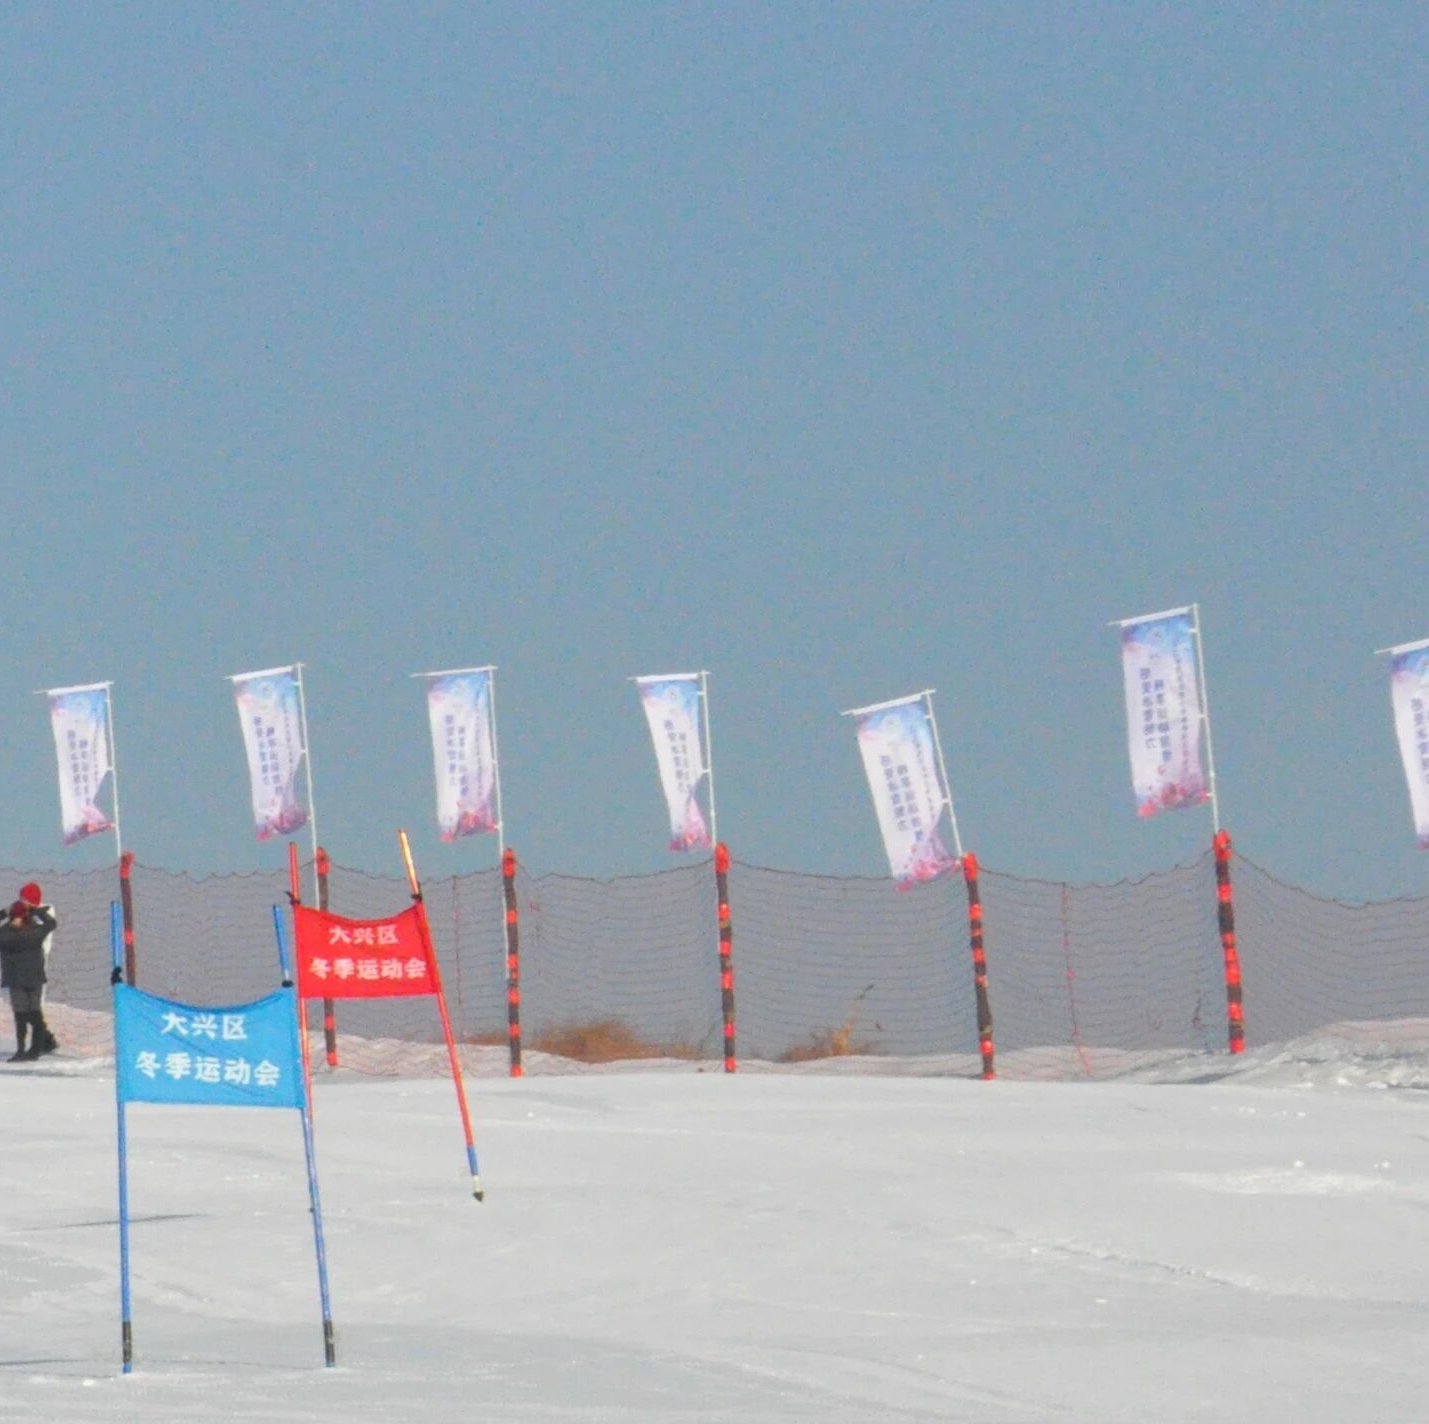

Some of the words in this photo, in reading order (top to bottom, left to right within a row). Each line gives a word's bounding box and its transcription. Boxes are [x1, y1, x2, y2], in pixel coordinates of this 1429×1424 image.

[328, 924, 400, 945] 大兴区
[309, 957, 427, 980] 冬季运动会
[161, 1012, 248, 1040] 大兴区
[135, 1051, 281, 1086] 冬季运动会
